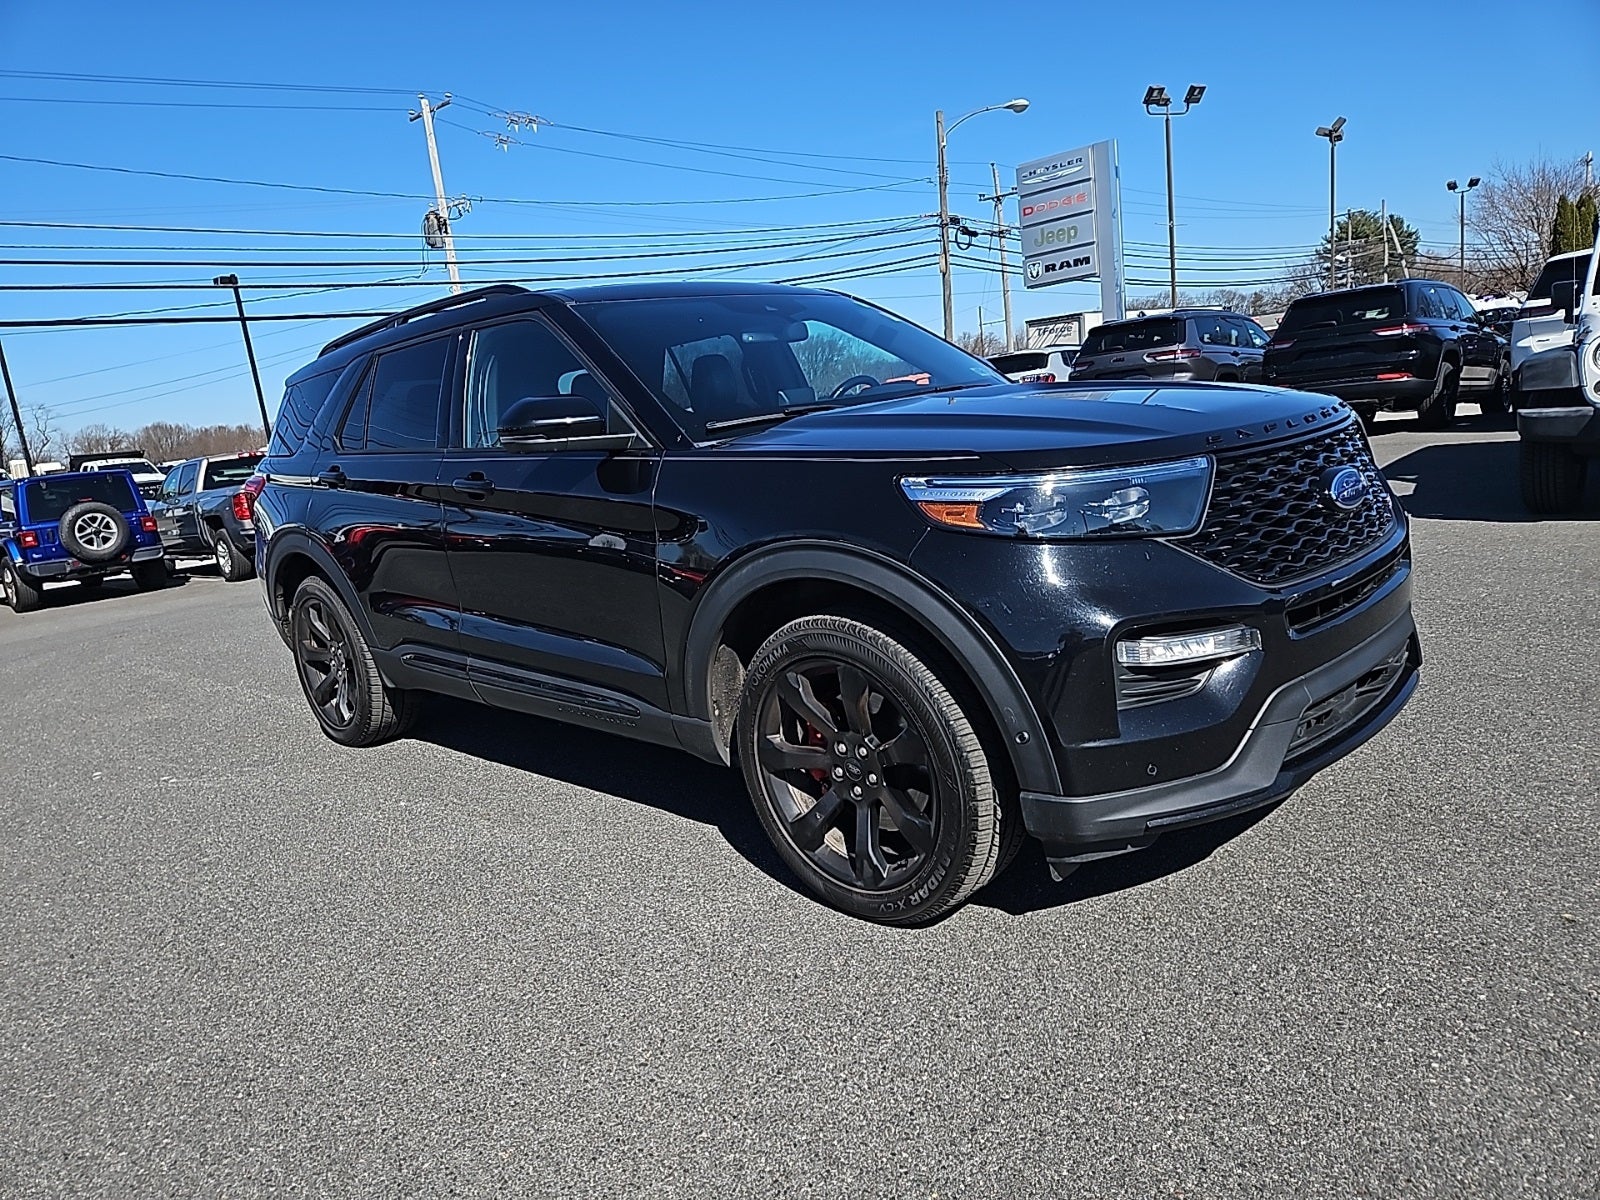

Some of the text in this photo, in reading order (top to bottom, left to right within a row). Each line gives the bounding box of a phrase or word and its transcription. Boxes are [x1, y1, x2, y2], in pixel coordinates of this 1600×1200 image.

[1022, 157, 1083, 178] CHRYSLER
[1023, 192, 1088, 217] DODGE
[1034, 225, 1078, 247] Jeep
[1044, 256, 1091, 273] RAM
